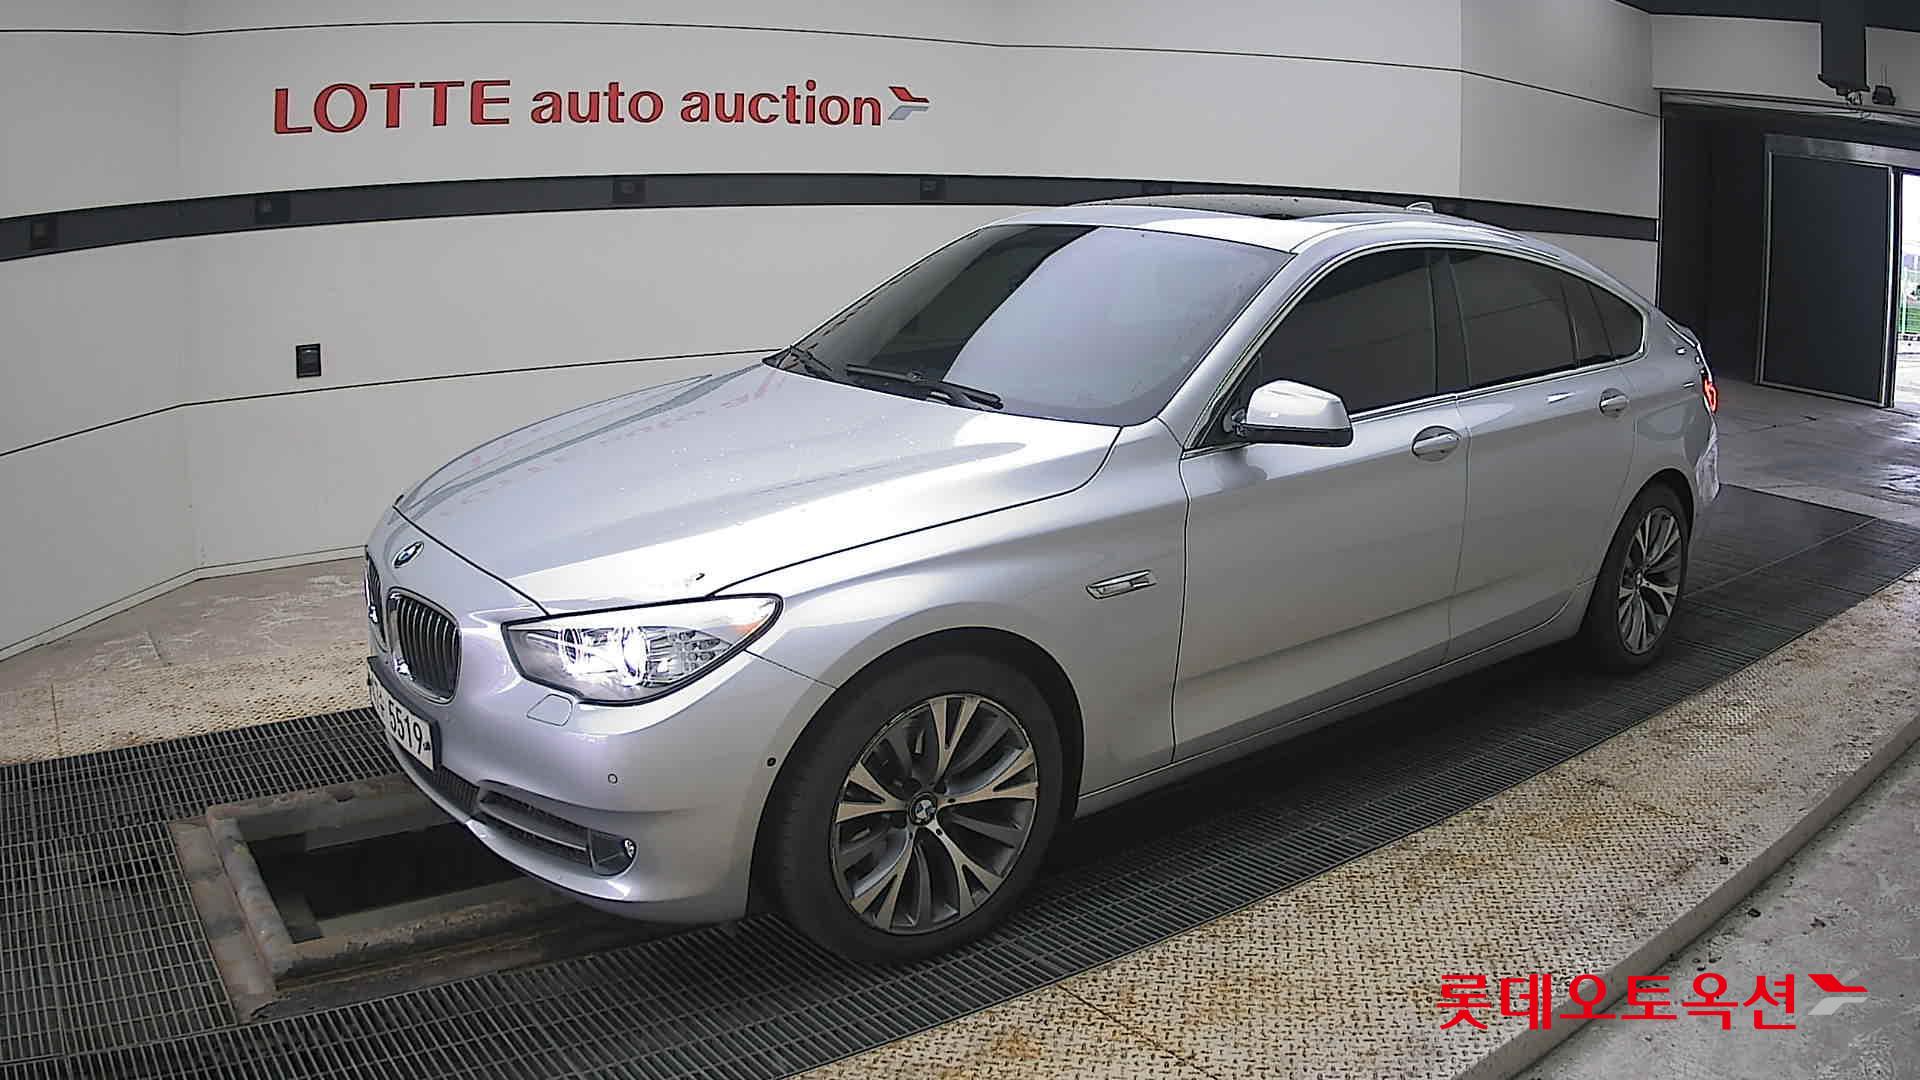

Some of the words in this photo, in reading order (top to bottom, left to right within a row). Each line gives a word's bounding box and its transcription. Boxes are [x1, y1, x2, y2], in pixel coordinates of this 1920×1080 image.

[274, 79, 512, 135] LOTTE
[530, 81, 664, 125] auto
[680, 79, 882, 127] auction
[388, 699, 423, 755] 5519
